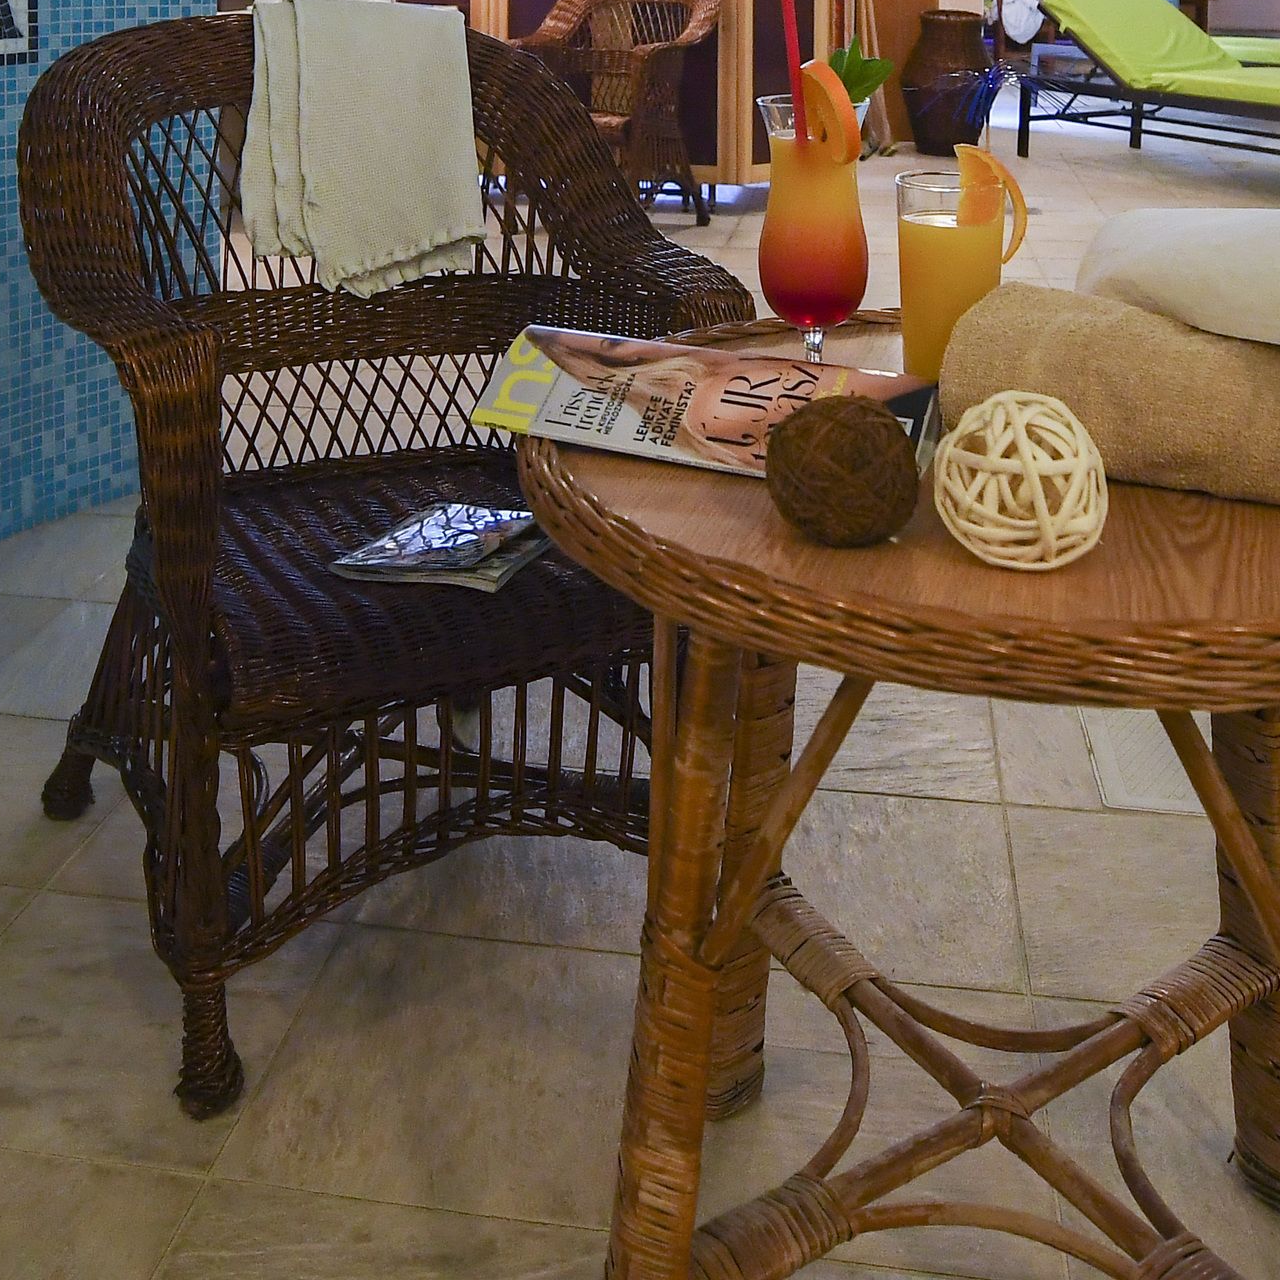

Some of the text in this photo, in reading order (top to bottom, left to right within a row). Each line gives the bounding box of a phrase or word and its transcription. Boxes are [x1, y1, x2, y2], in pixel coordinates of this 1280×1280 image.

[574, 373, 617, 431] trendek
[632, 395, 663, 443] LEHET-E
[648, 398, 675, 446] A DIVAT
[660, 380, 697, 448] FEMINISTA?
